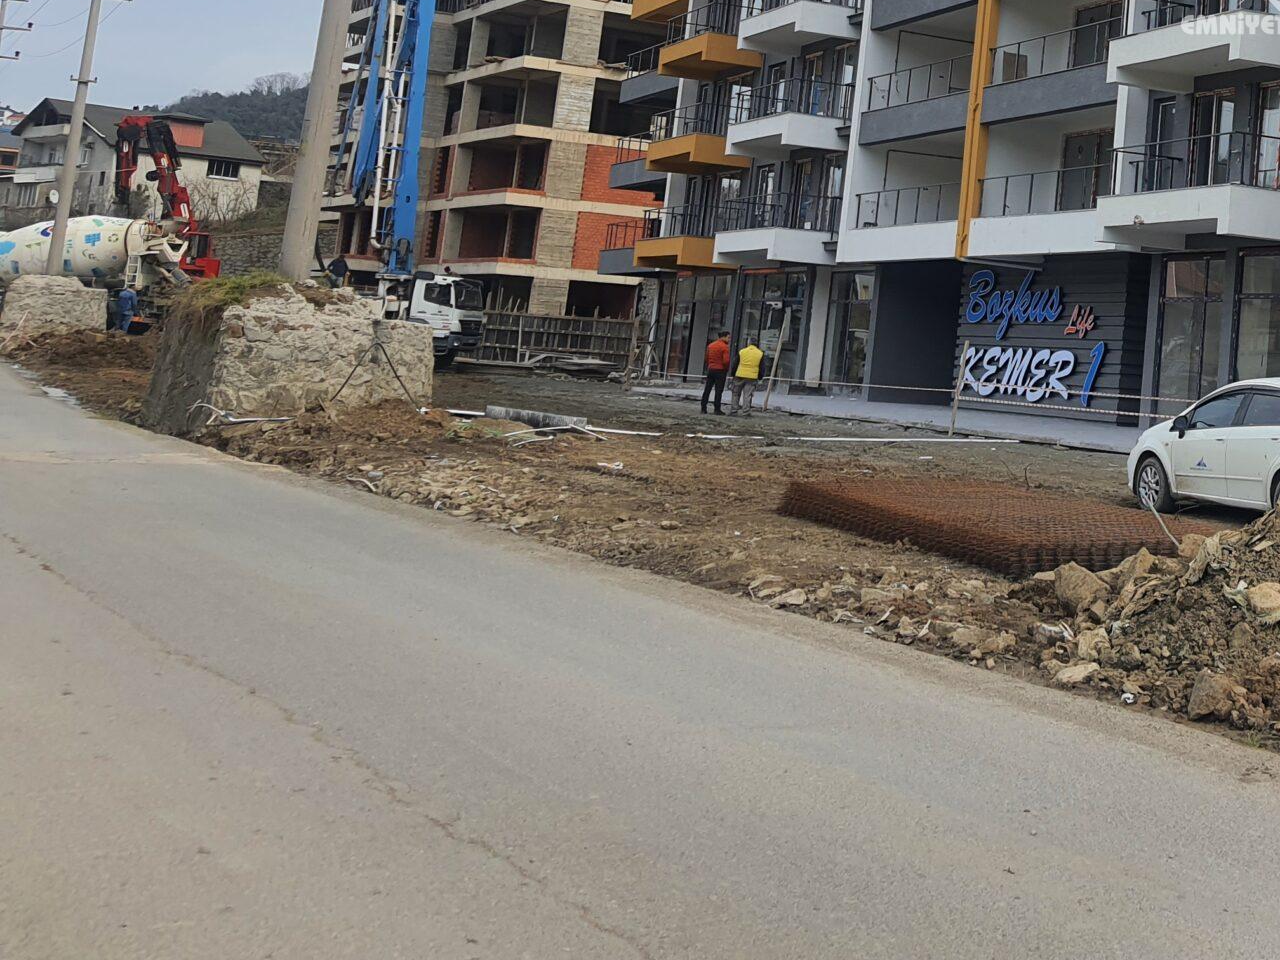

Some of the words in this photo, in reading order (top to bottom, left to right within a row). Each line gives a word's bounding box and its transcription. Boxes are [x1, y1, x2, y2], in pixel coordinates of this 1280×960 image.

[1064, 304, 1095, 339] Life
[960, 346, 1075, 402] KEMER
[1080, 341, 1105, 407] 1
